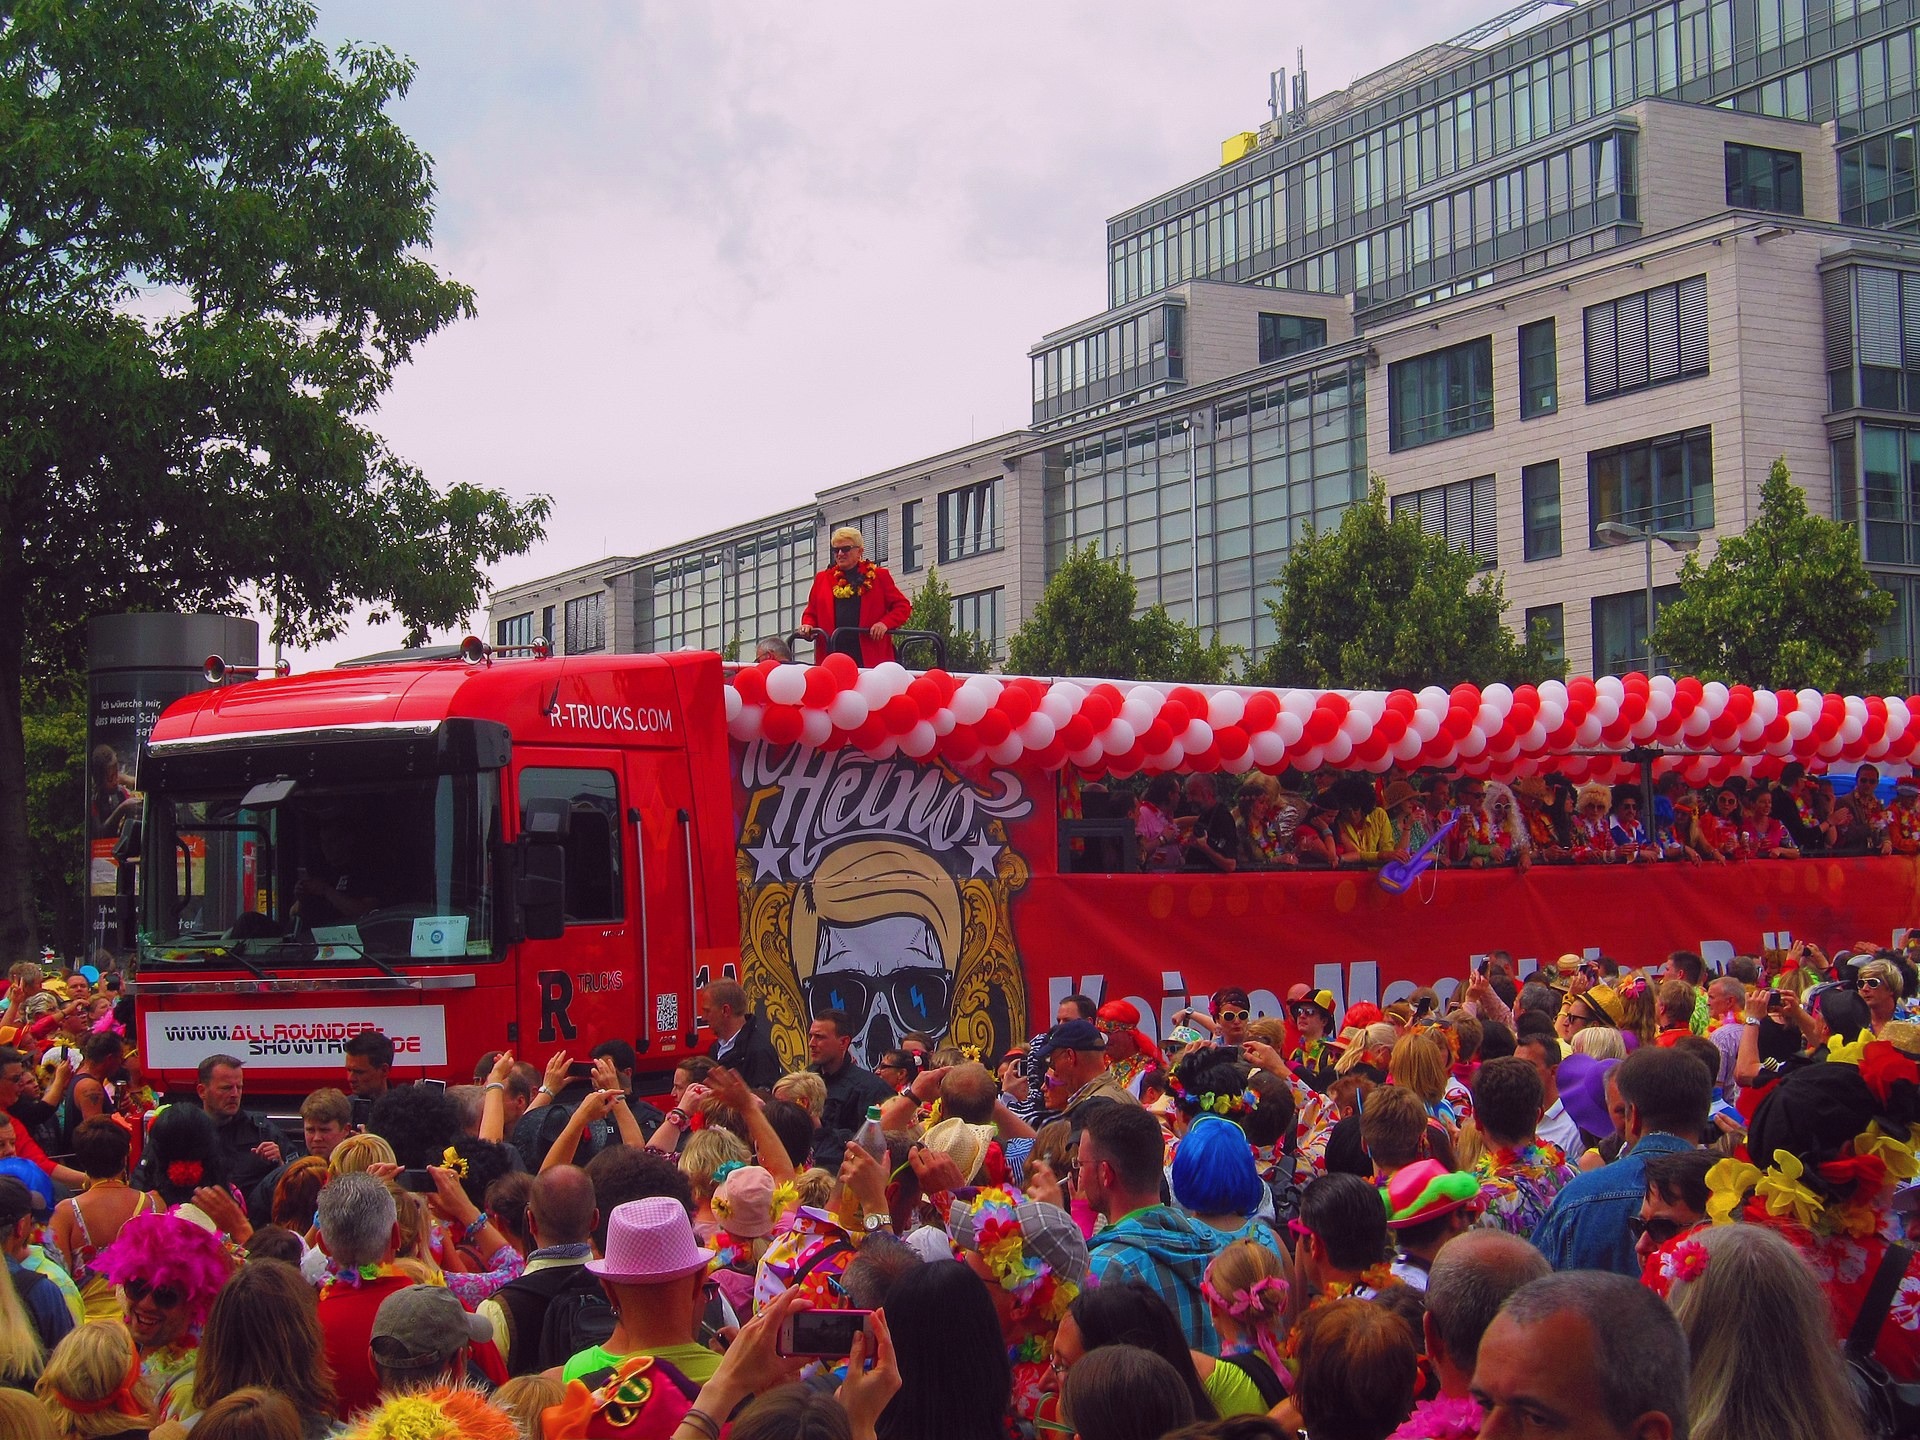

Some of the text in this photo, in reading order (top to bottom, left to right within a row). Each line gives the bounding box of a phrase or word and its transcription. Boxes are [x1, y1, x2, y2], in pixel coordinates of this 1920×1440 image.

[101, 701, 109, 709] Ich
[111, 699, 142, 709] wünsche
[109, 714, 135, 724] meine
[139, 712, 160, 723] Sch
[550, 703, 672, 732] R-TRUCKS.COM
[742, 740, 1032, 878] Heino
[537, 969, 623, 1043] R TRUCKS
